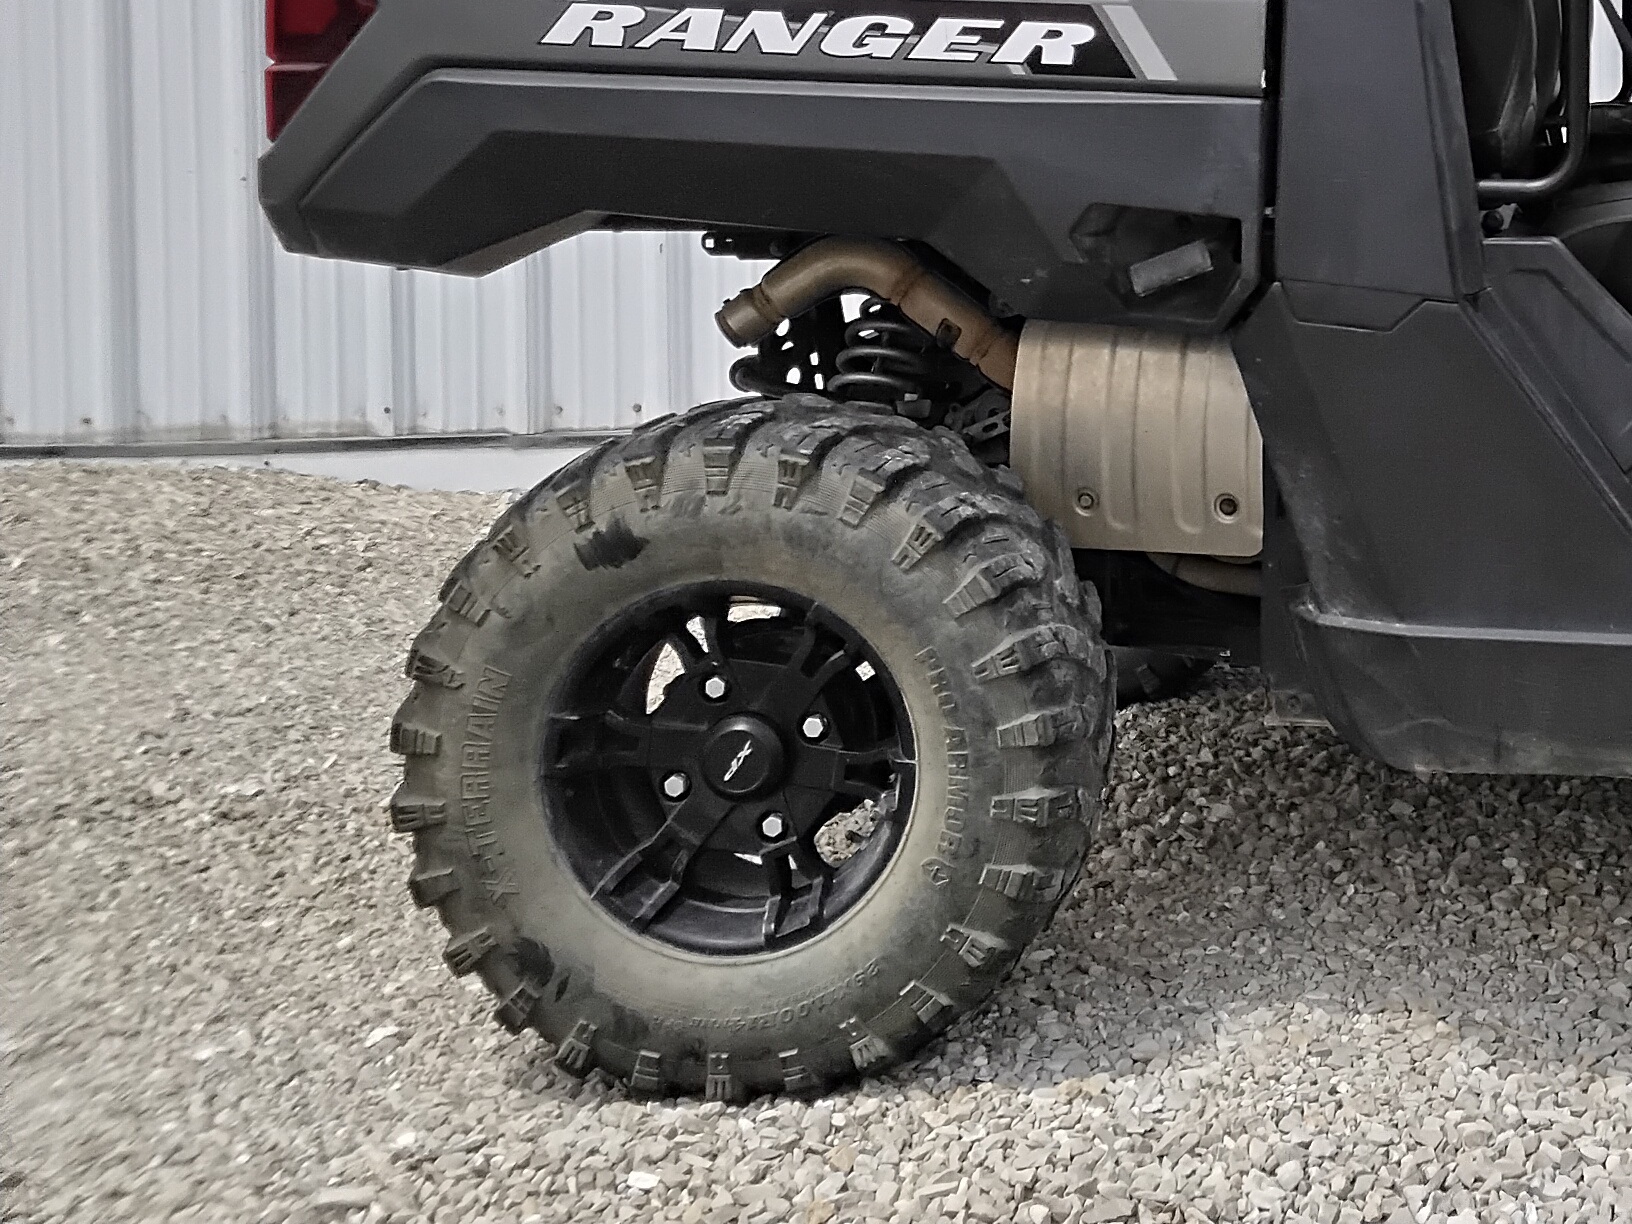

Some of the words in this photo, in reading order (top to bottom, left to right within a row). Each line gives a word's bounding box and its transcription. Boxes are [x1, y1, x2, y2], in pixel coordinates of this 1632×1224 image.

[540, 2, 1096, 66] RANGER
[460, 664, 521, 906] X-TERRAIN
[936, 725, 971, 860] ARMOR
